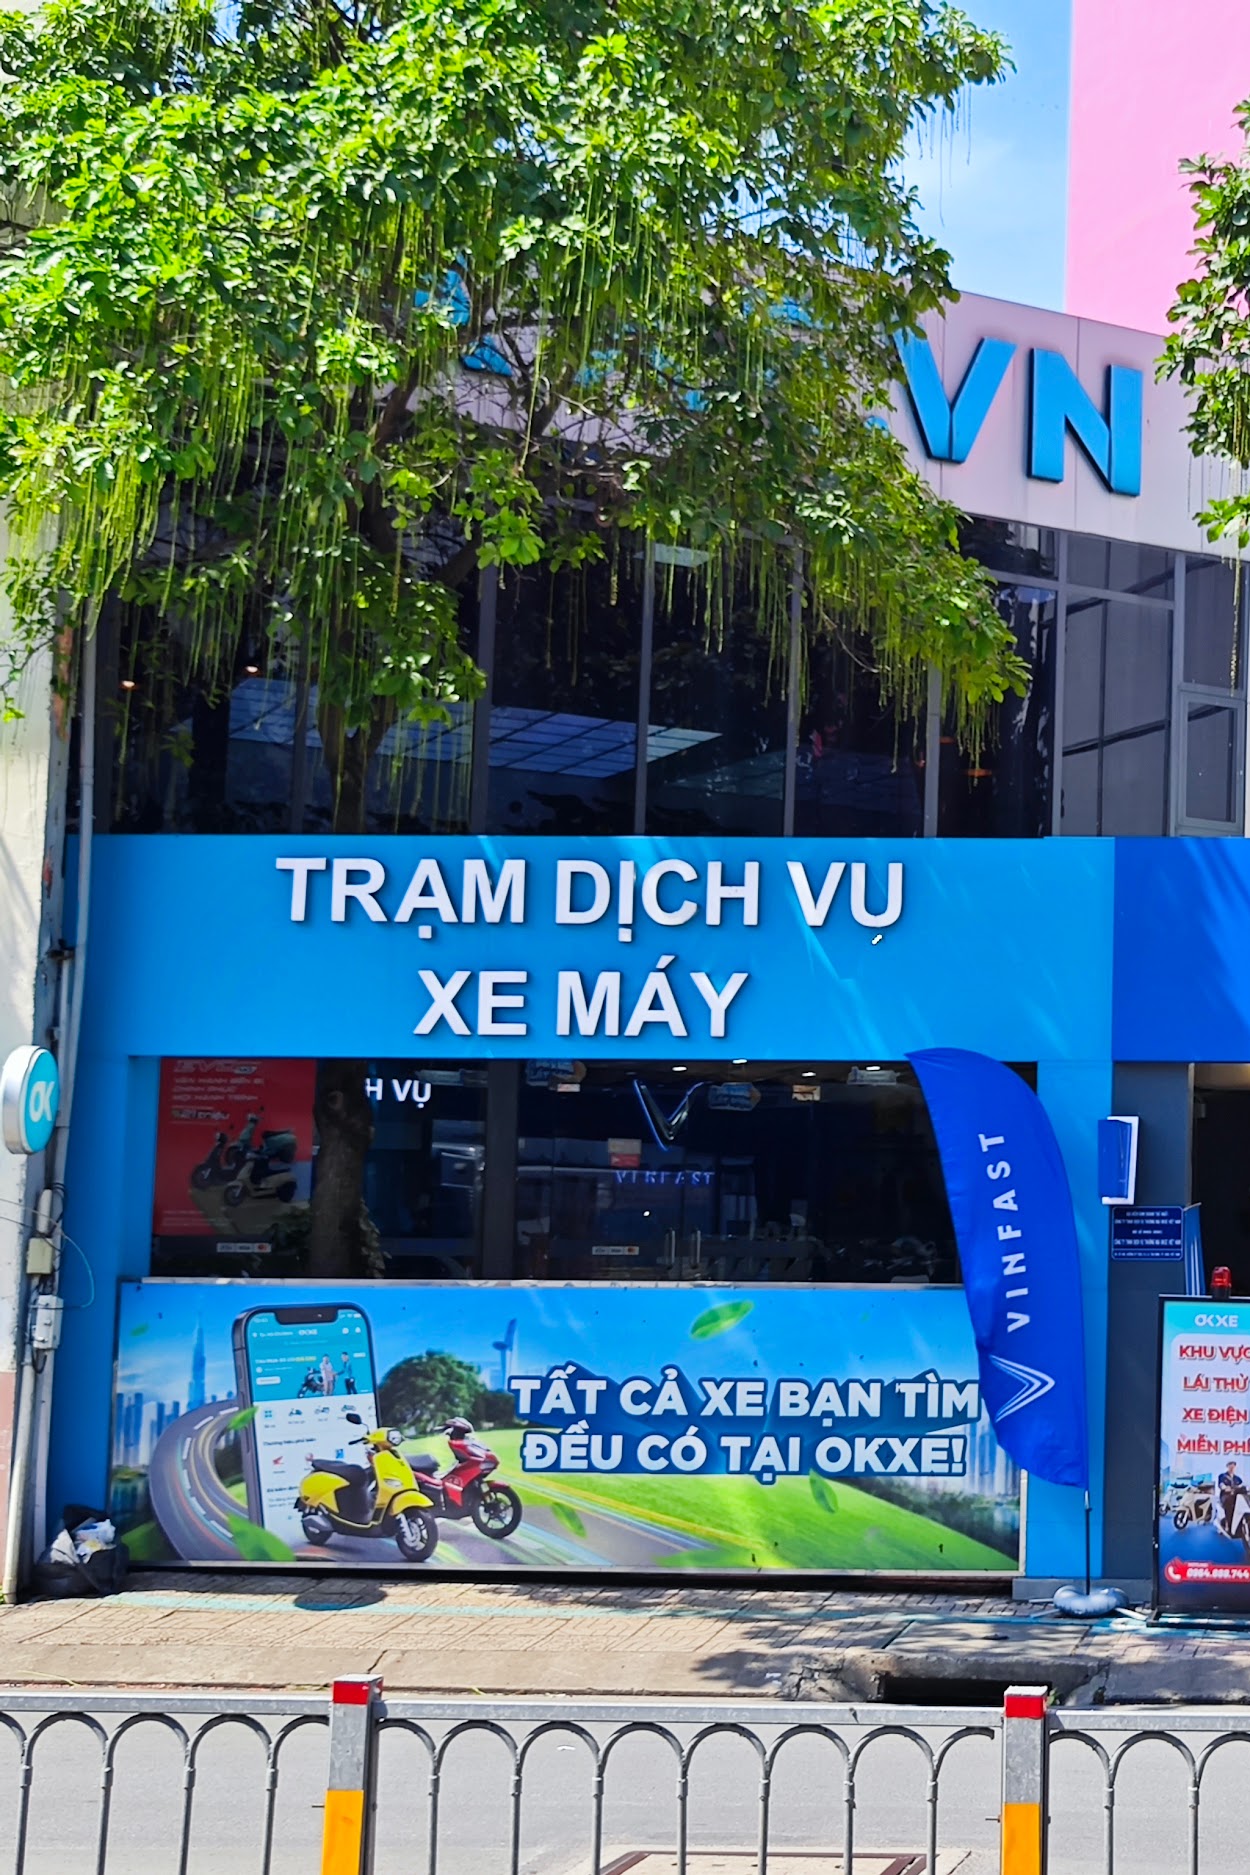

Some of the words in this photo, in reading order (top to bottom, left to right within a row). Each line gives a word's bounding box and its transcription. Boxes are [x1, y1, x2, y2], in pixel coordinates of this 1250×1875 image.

[275, 857, 526, 939] TRẠM
[555, 860, 760, 942] DỊCH
[786, 861, 904, 945] VỤ
[412, 969, 529, 1037] XE
[555, 954, 749, 1039] MÁY
[392, 1078, 432, 1109] VỤ
[977, 1133, 1031, 1334] VINFAST
[1194, 1314, 1239, 1328] OKXE
[1179, 1346, 1215, 1359] KHU
[510, 1363, 612, 1416] TẤT
[618, 1367, 687, 1417] CẢ
[701, 1380, 764, 1417] XE
[779, 1380, 882, 1428] BẠN
[895, 1372, 980, 1418] TÌM
[1183, 1374, 1209, 1390] LÁI
[1213, 1373, 1250, 1391] THỬ
[1183, 1408, 1204, 1421] XE
[1208, 1405, 1248, 1425] ĐIỆN
[523, 1419, 623, 1470] ĐỀU
[636, 1425, 708, 1472] CÓ
[720, 1436, 800, 1482] TẠI
[815, 1435, 964, 1473] OKXE!
[1177, 1434, 1219, 1453] MIỄN
